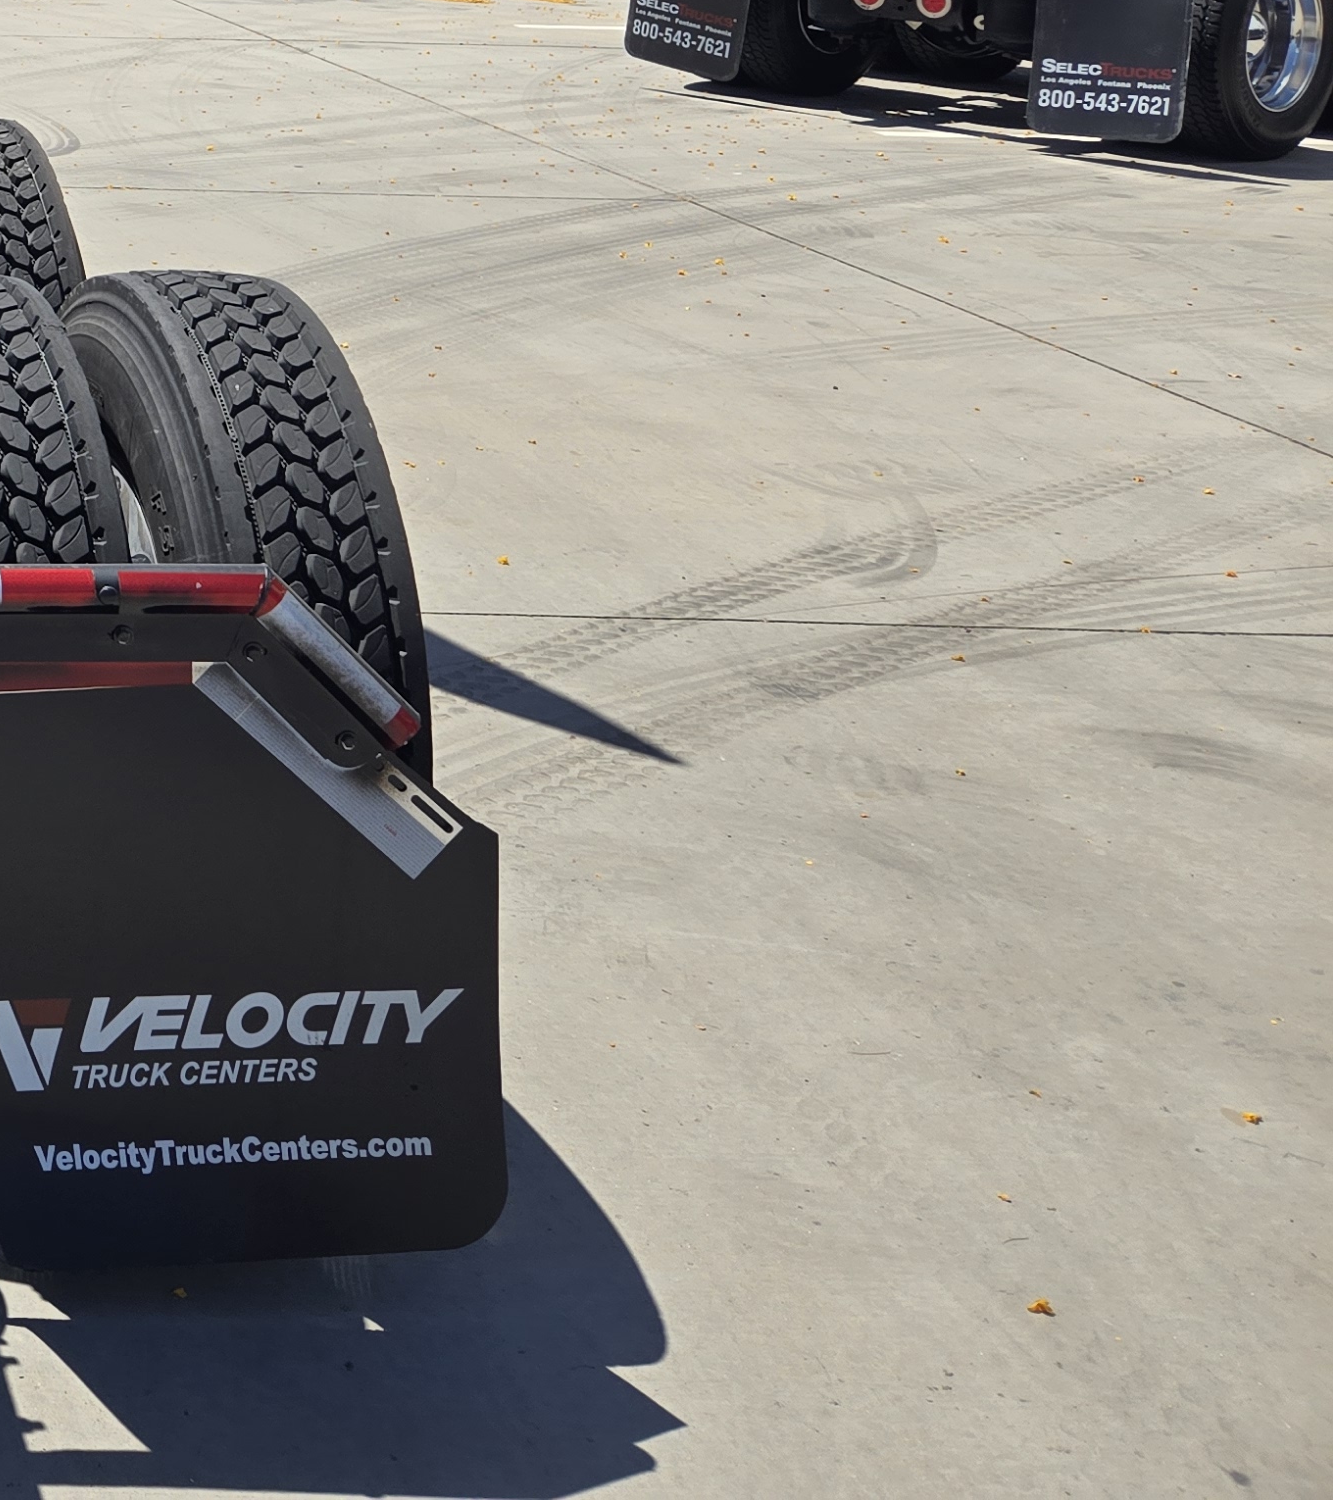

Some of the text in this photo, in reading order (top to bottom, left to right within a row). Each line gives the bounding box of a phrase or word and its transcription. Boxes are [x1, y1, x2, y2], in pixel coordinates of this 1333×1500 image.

[632, 19, 731, 59] 800-543-7621
[635, 7, 732, 38] Los Angeles Fontana Phoenix
[1040, 75, 1171, 91] Los Angeles Fontana Phoenix
[1038, 88, 1170, 117] 800-543-7621
[79, 987, 465, 1053] VELOCITY
[71, 1057, 318, 1090] TRUCK CENTERS
[33, 1134, 433, 1175] VelocityTruckCenters.com
